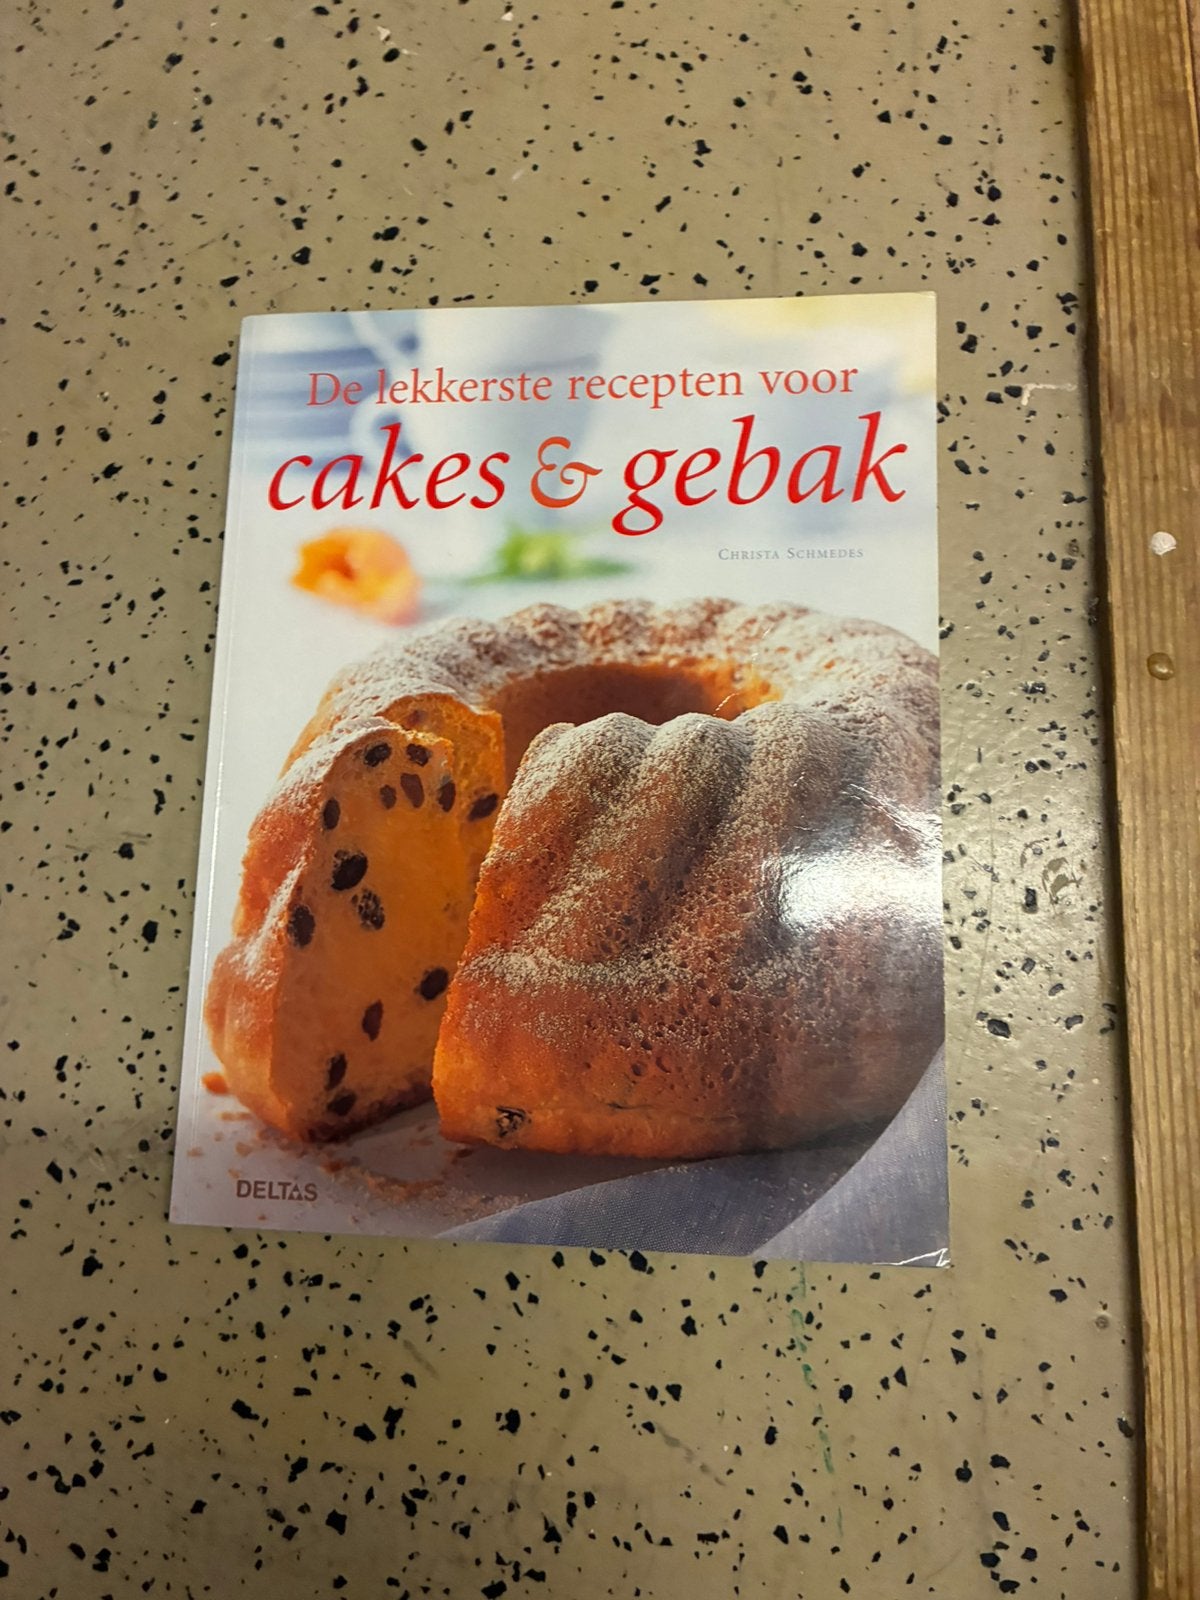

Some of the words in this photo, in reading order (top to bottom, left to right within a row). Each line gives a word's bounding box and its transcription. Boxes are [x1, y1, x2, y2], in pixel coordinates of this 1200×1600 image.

[308, 372, 363, 407] De
[377, 366, 552, 406] lekkerste
[567, 369, 743, 411] recepten
[758, 367, 859, 396] voor
[267, 422, 511, 512] cakes
[529, 436, 603, 510] &
[610, 411, 908, 537] gebak
[235, 1179, 318, 1202] DELTAS
